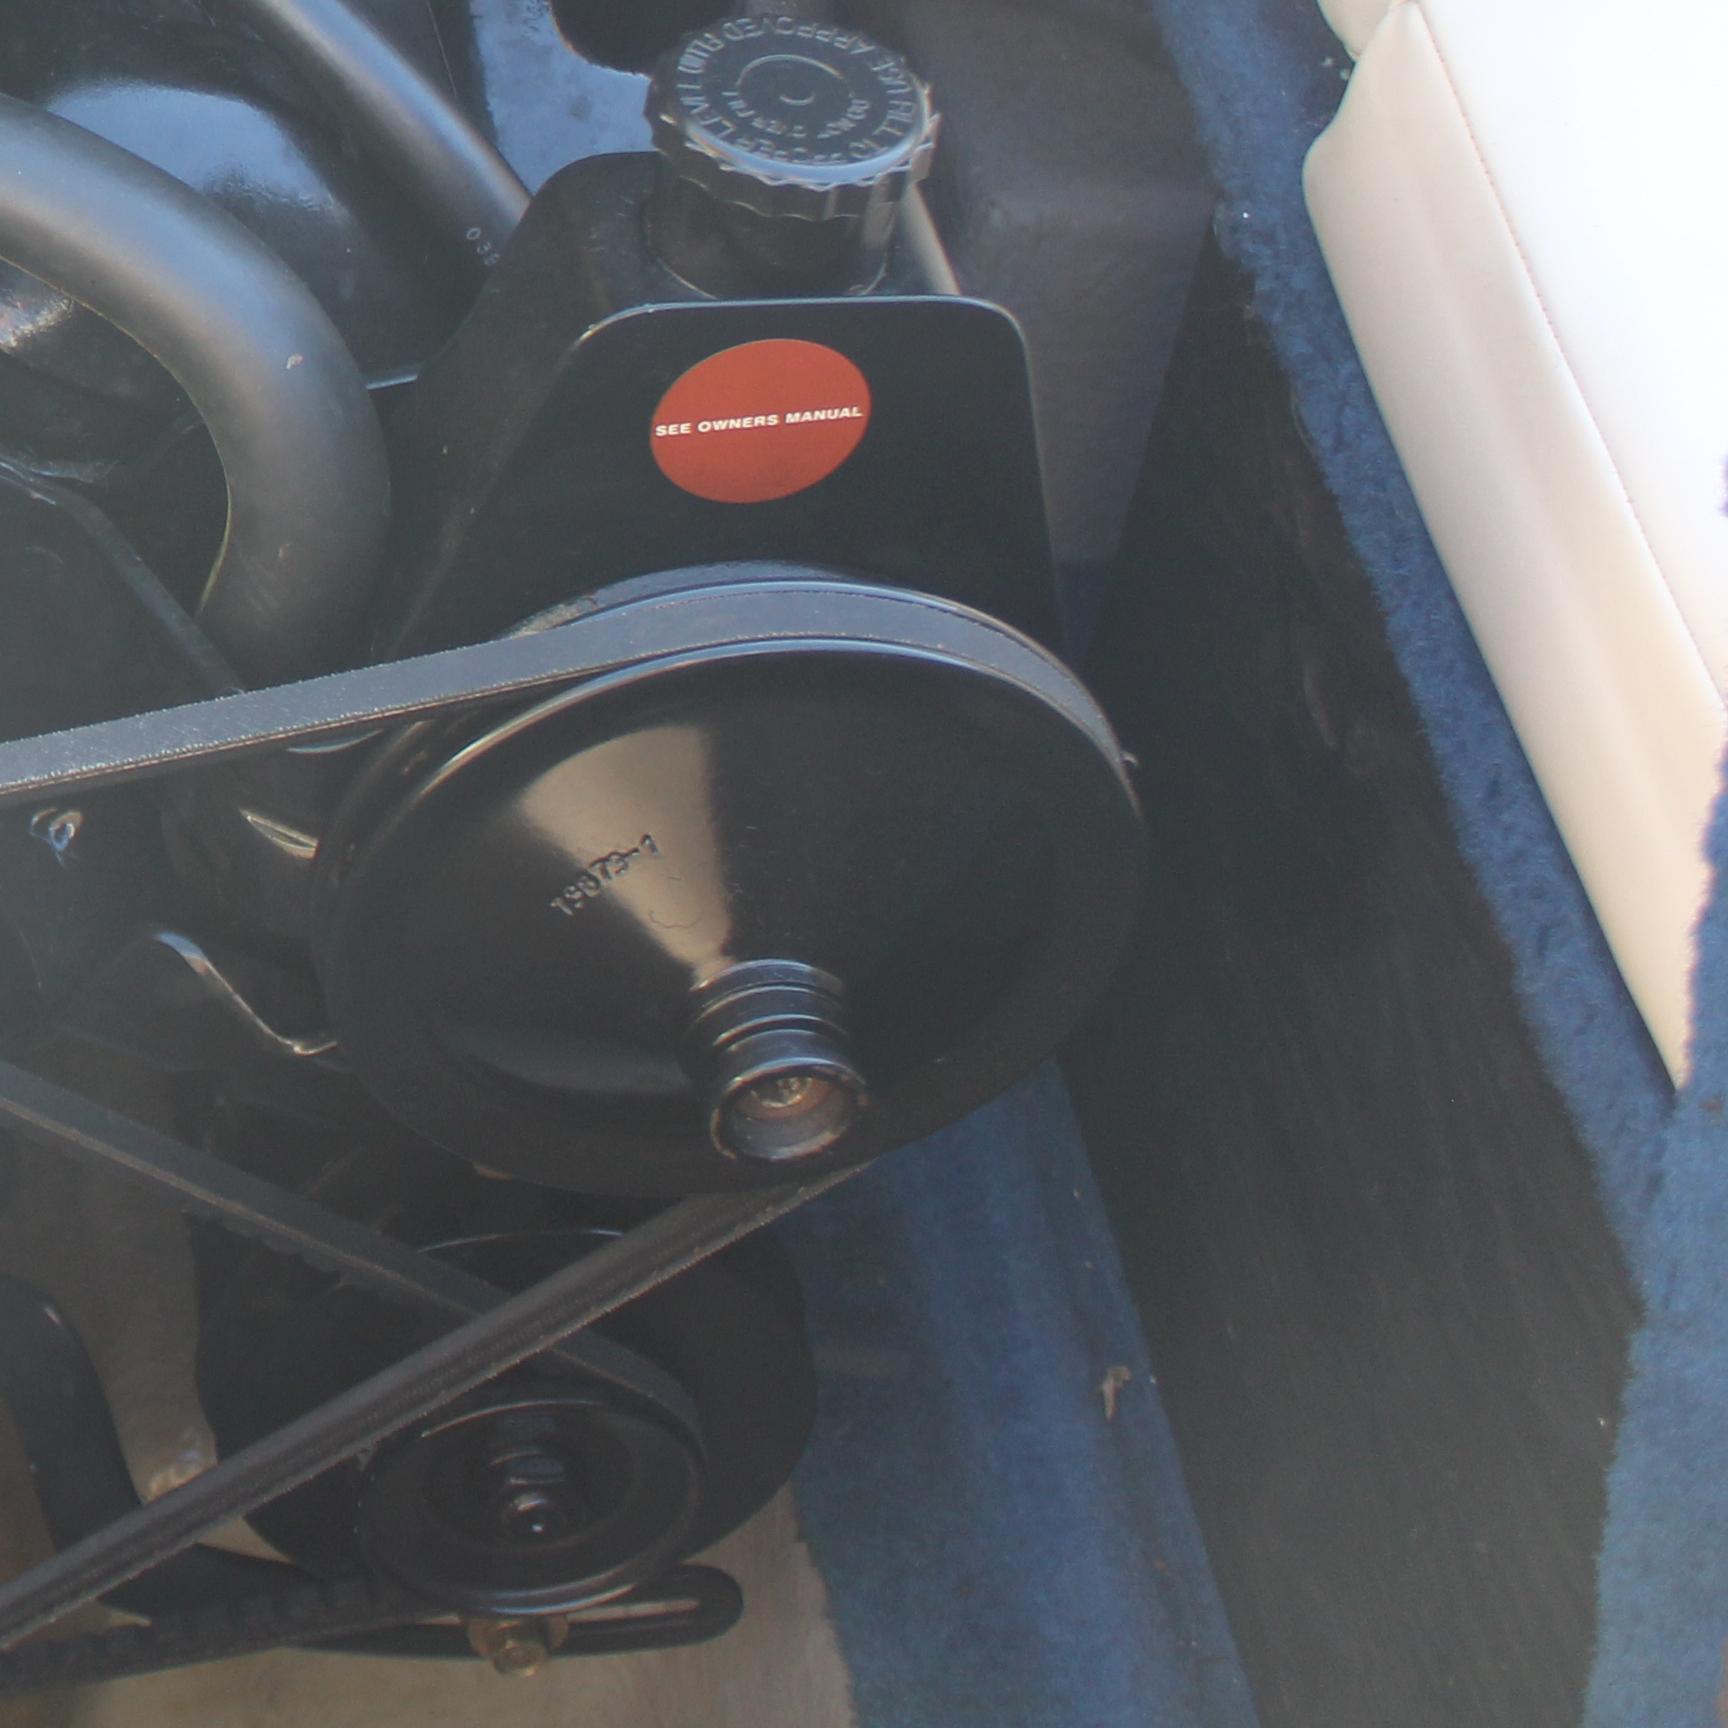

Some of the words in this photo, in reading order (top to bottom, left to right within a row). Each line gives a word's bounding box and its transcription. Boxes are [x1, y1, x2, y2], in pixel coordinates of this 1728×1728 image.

[655, 422, 692, 437] SEE
[697, 414, 780, 433] OWNERS
[784, 405, 864, 424] MANUAL
